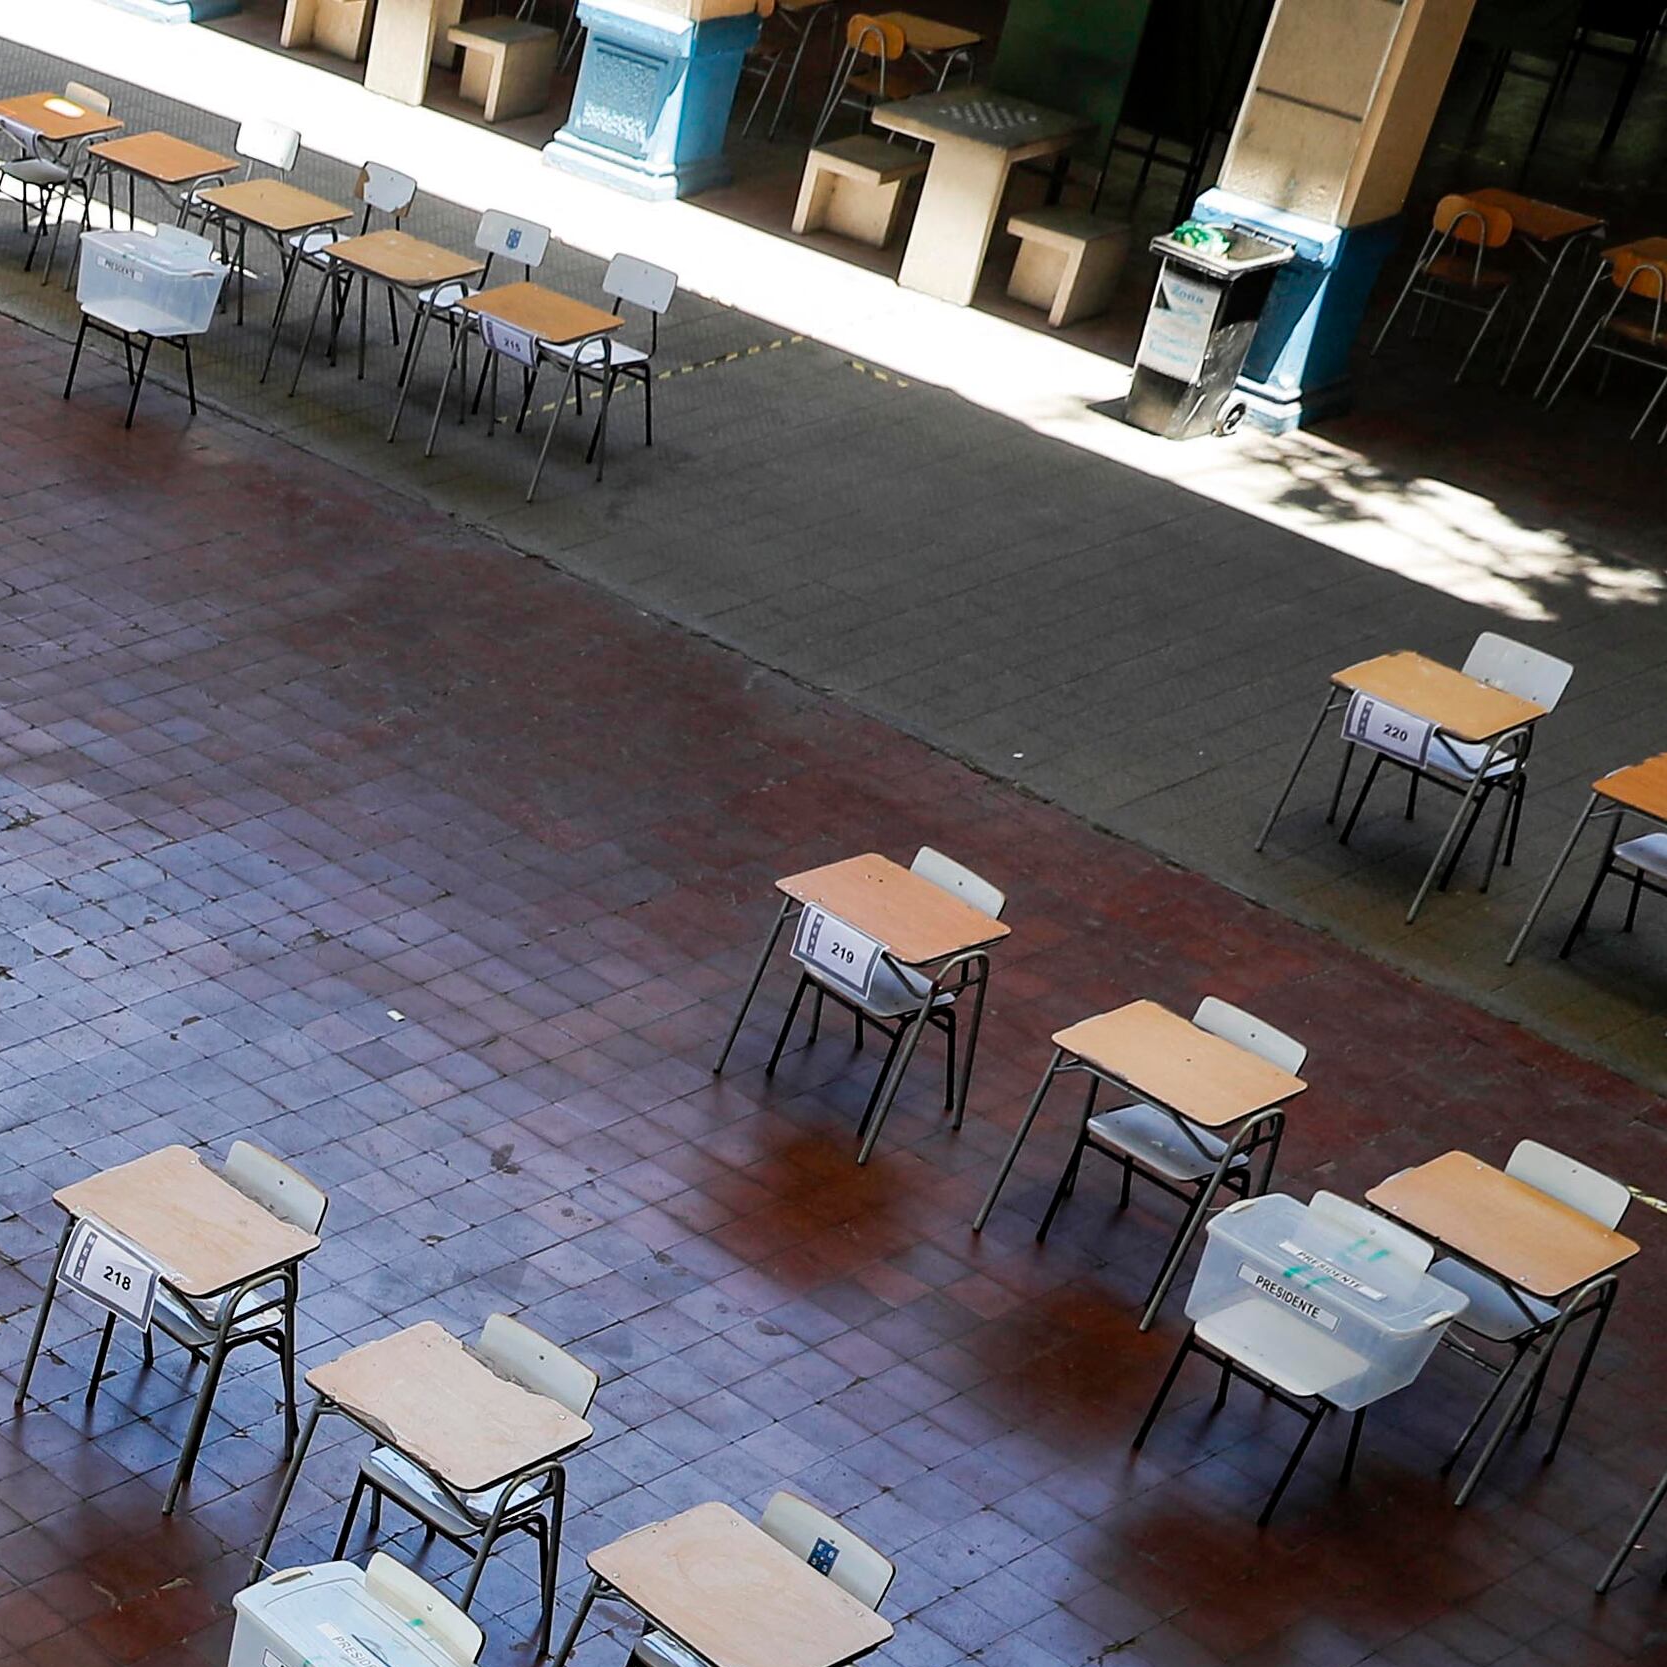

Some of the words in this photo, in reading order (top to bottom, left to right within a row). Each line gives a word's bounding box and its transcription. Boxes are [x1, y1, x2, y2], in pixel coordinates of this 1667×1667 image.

[1383, 723, 1408, 742] 220
[831, 942, 855, 964] 219
[103, 1265, 131, 1291] 218
[1297, 1250, 1361, 1289] PRESIDENTE
[1255, 1275, 1320, 1320] PRESIDENTE
